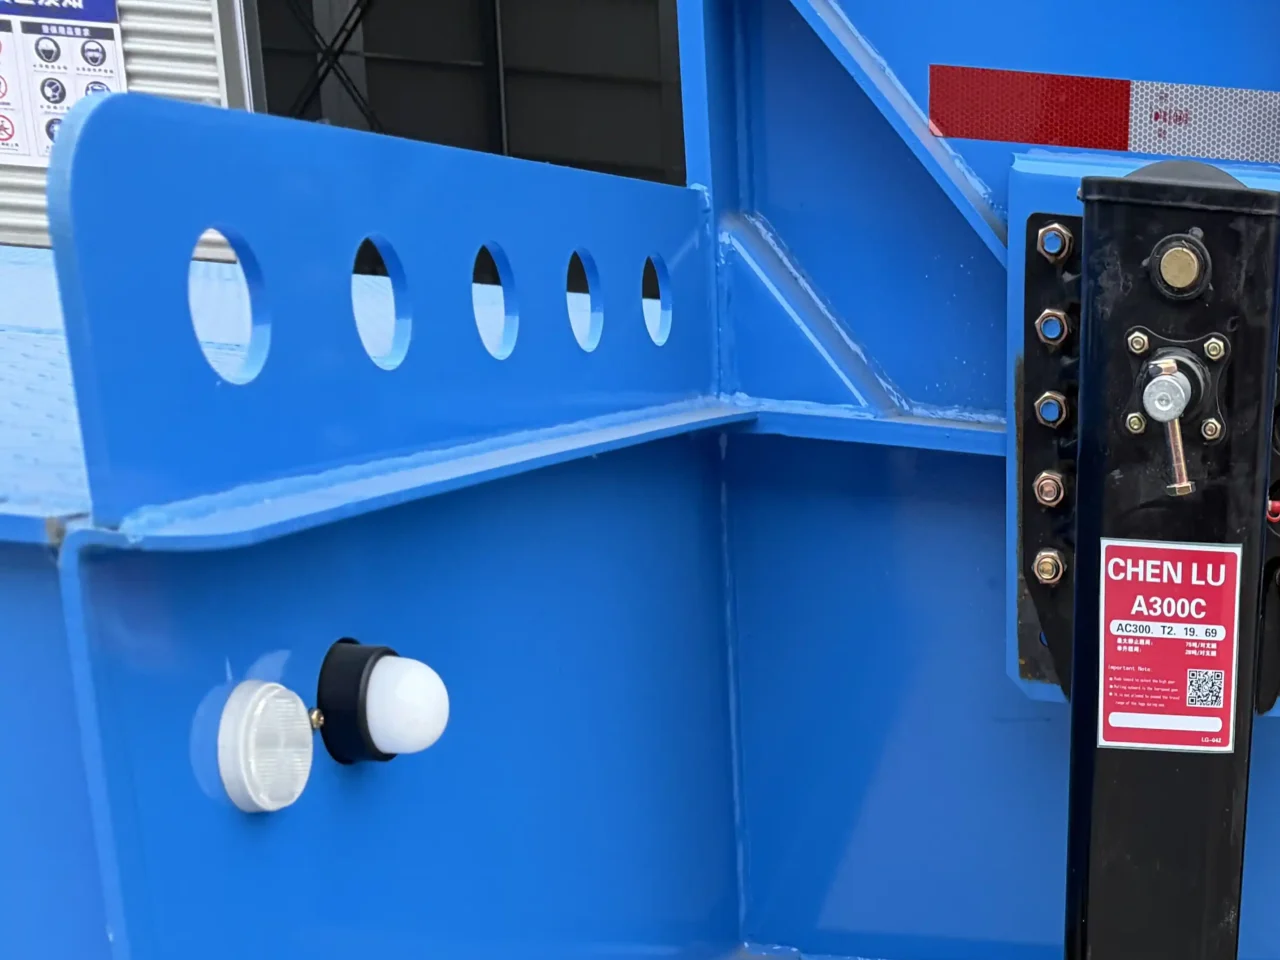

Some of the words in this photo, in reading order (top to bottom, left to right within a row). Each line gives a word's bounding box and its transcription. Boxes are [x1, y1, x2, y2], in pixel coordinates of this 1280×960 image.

[1107, 557, 1183, 584] CHEN
[1191, 562, 1226, 587] LU
[1130, 594, 1207, 619] A300C
[1116, 623, 1154, 635] AC300.
[1160, 625, 1176, 636] T2.
[1183, 626, 1198, 637] 19.
[1204, 628, 1217, 638] 69
